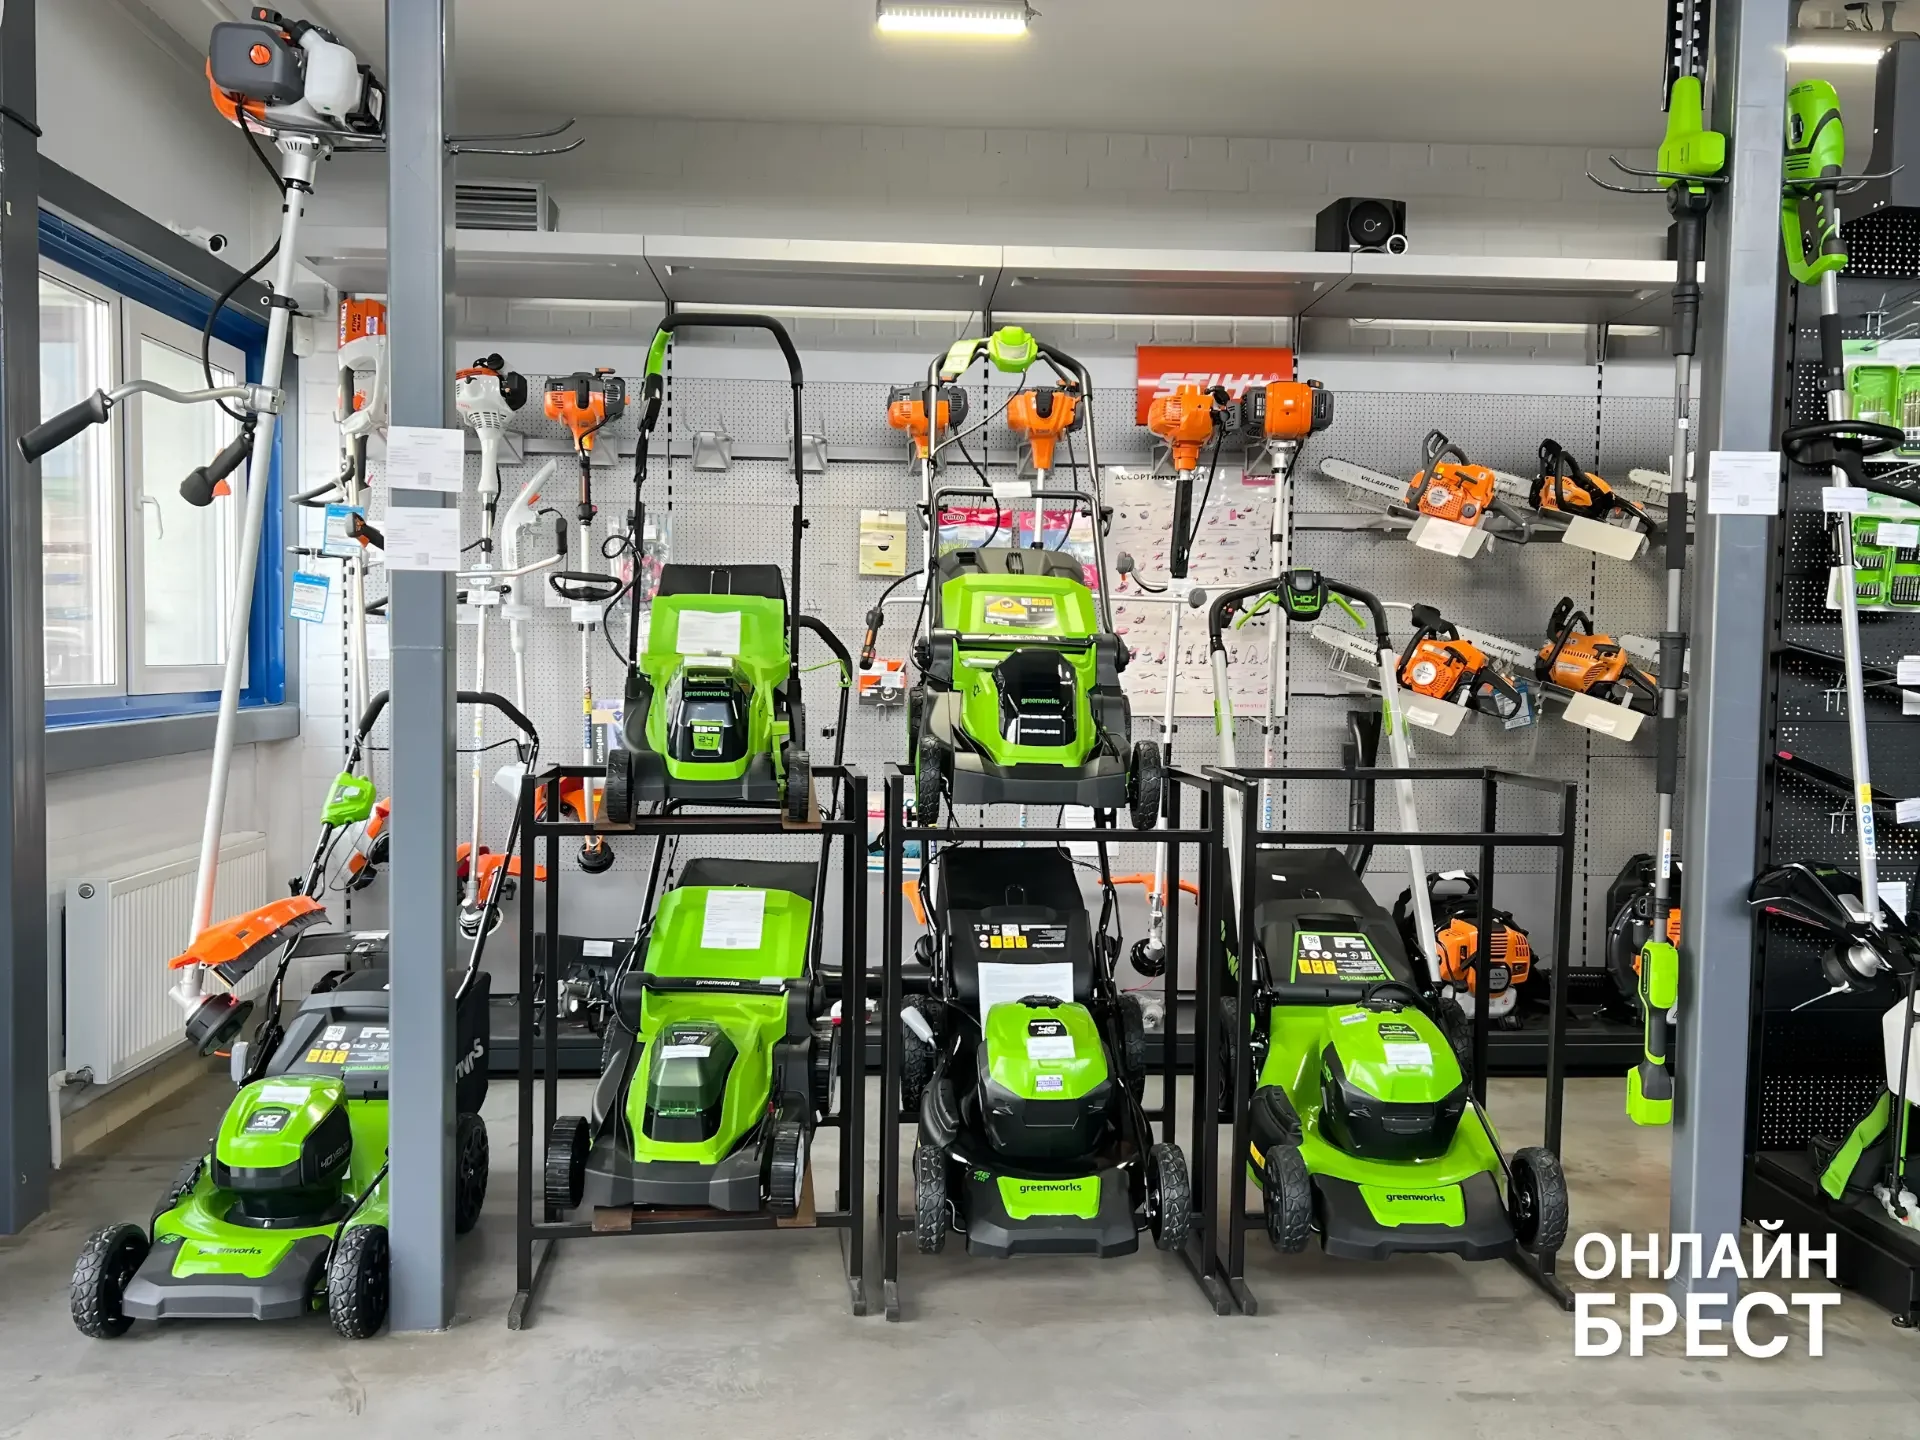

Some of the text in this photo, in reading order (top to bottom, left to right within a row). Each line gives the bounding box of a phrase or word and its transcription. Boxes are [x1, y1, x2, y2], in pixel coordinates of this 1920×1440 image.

[1361, 475, 1400, 491] VILLARTEC
[684, 690, 730, 698] greenworks
[1020, 1183, 1082, 1193] greenworks
[1386, 1194, 1446, 1202] greenworks
[197, 1247, 262, 1255] genworks
